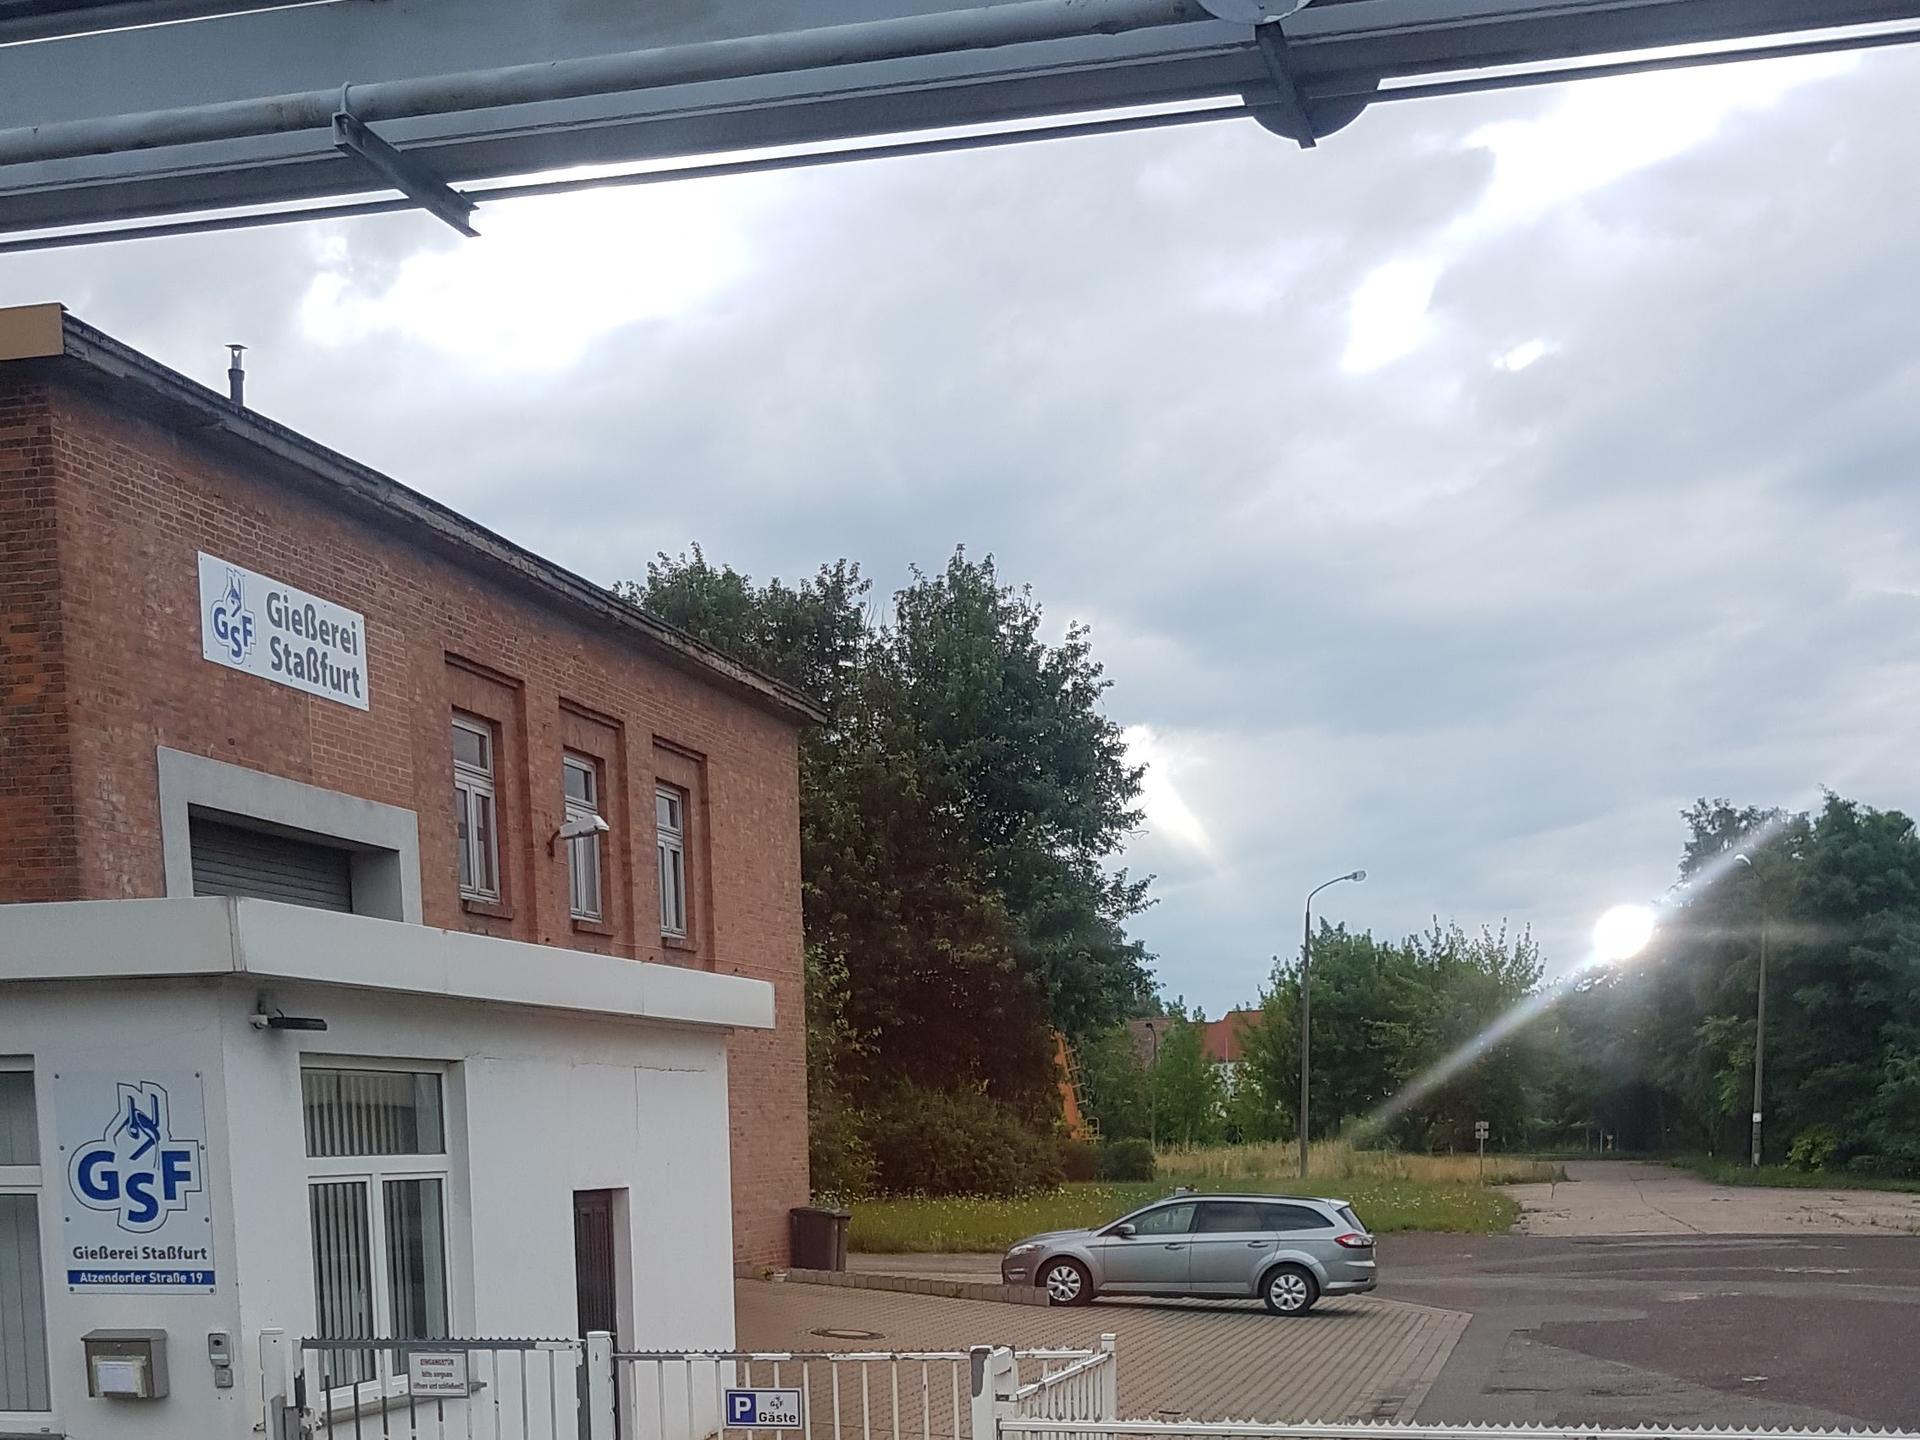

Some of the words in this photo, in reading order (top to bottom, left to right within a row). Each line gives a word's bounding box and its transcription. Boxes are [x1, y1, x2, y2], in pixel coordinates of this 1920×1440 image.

[213, 607, 252, 658] GSF
[266, 592, 357, 656] Gießerei
[270, 636, 360, 698] Staßfurt
[78, 1151, 191, 1223] GSF
[73, 1246, 137, 1260] Gießerei
[142, 1246, 207, 1260] Staßfurt
[80, 1272, 147, 1283] Atzendorfer
[149, 1272, 186, 1283] Straße
[190, 1272, 203, 1283] 19
[735, 1397, 752, 1419] P
[759, 1412, 796, 1423] Gäste
